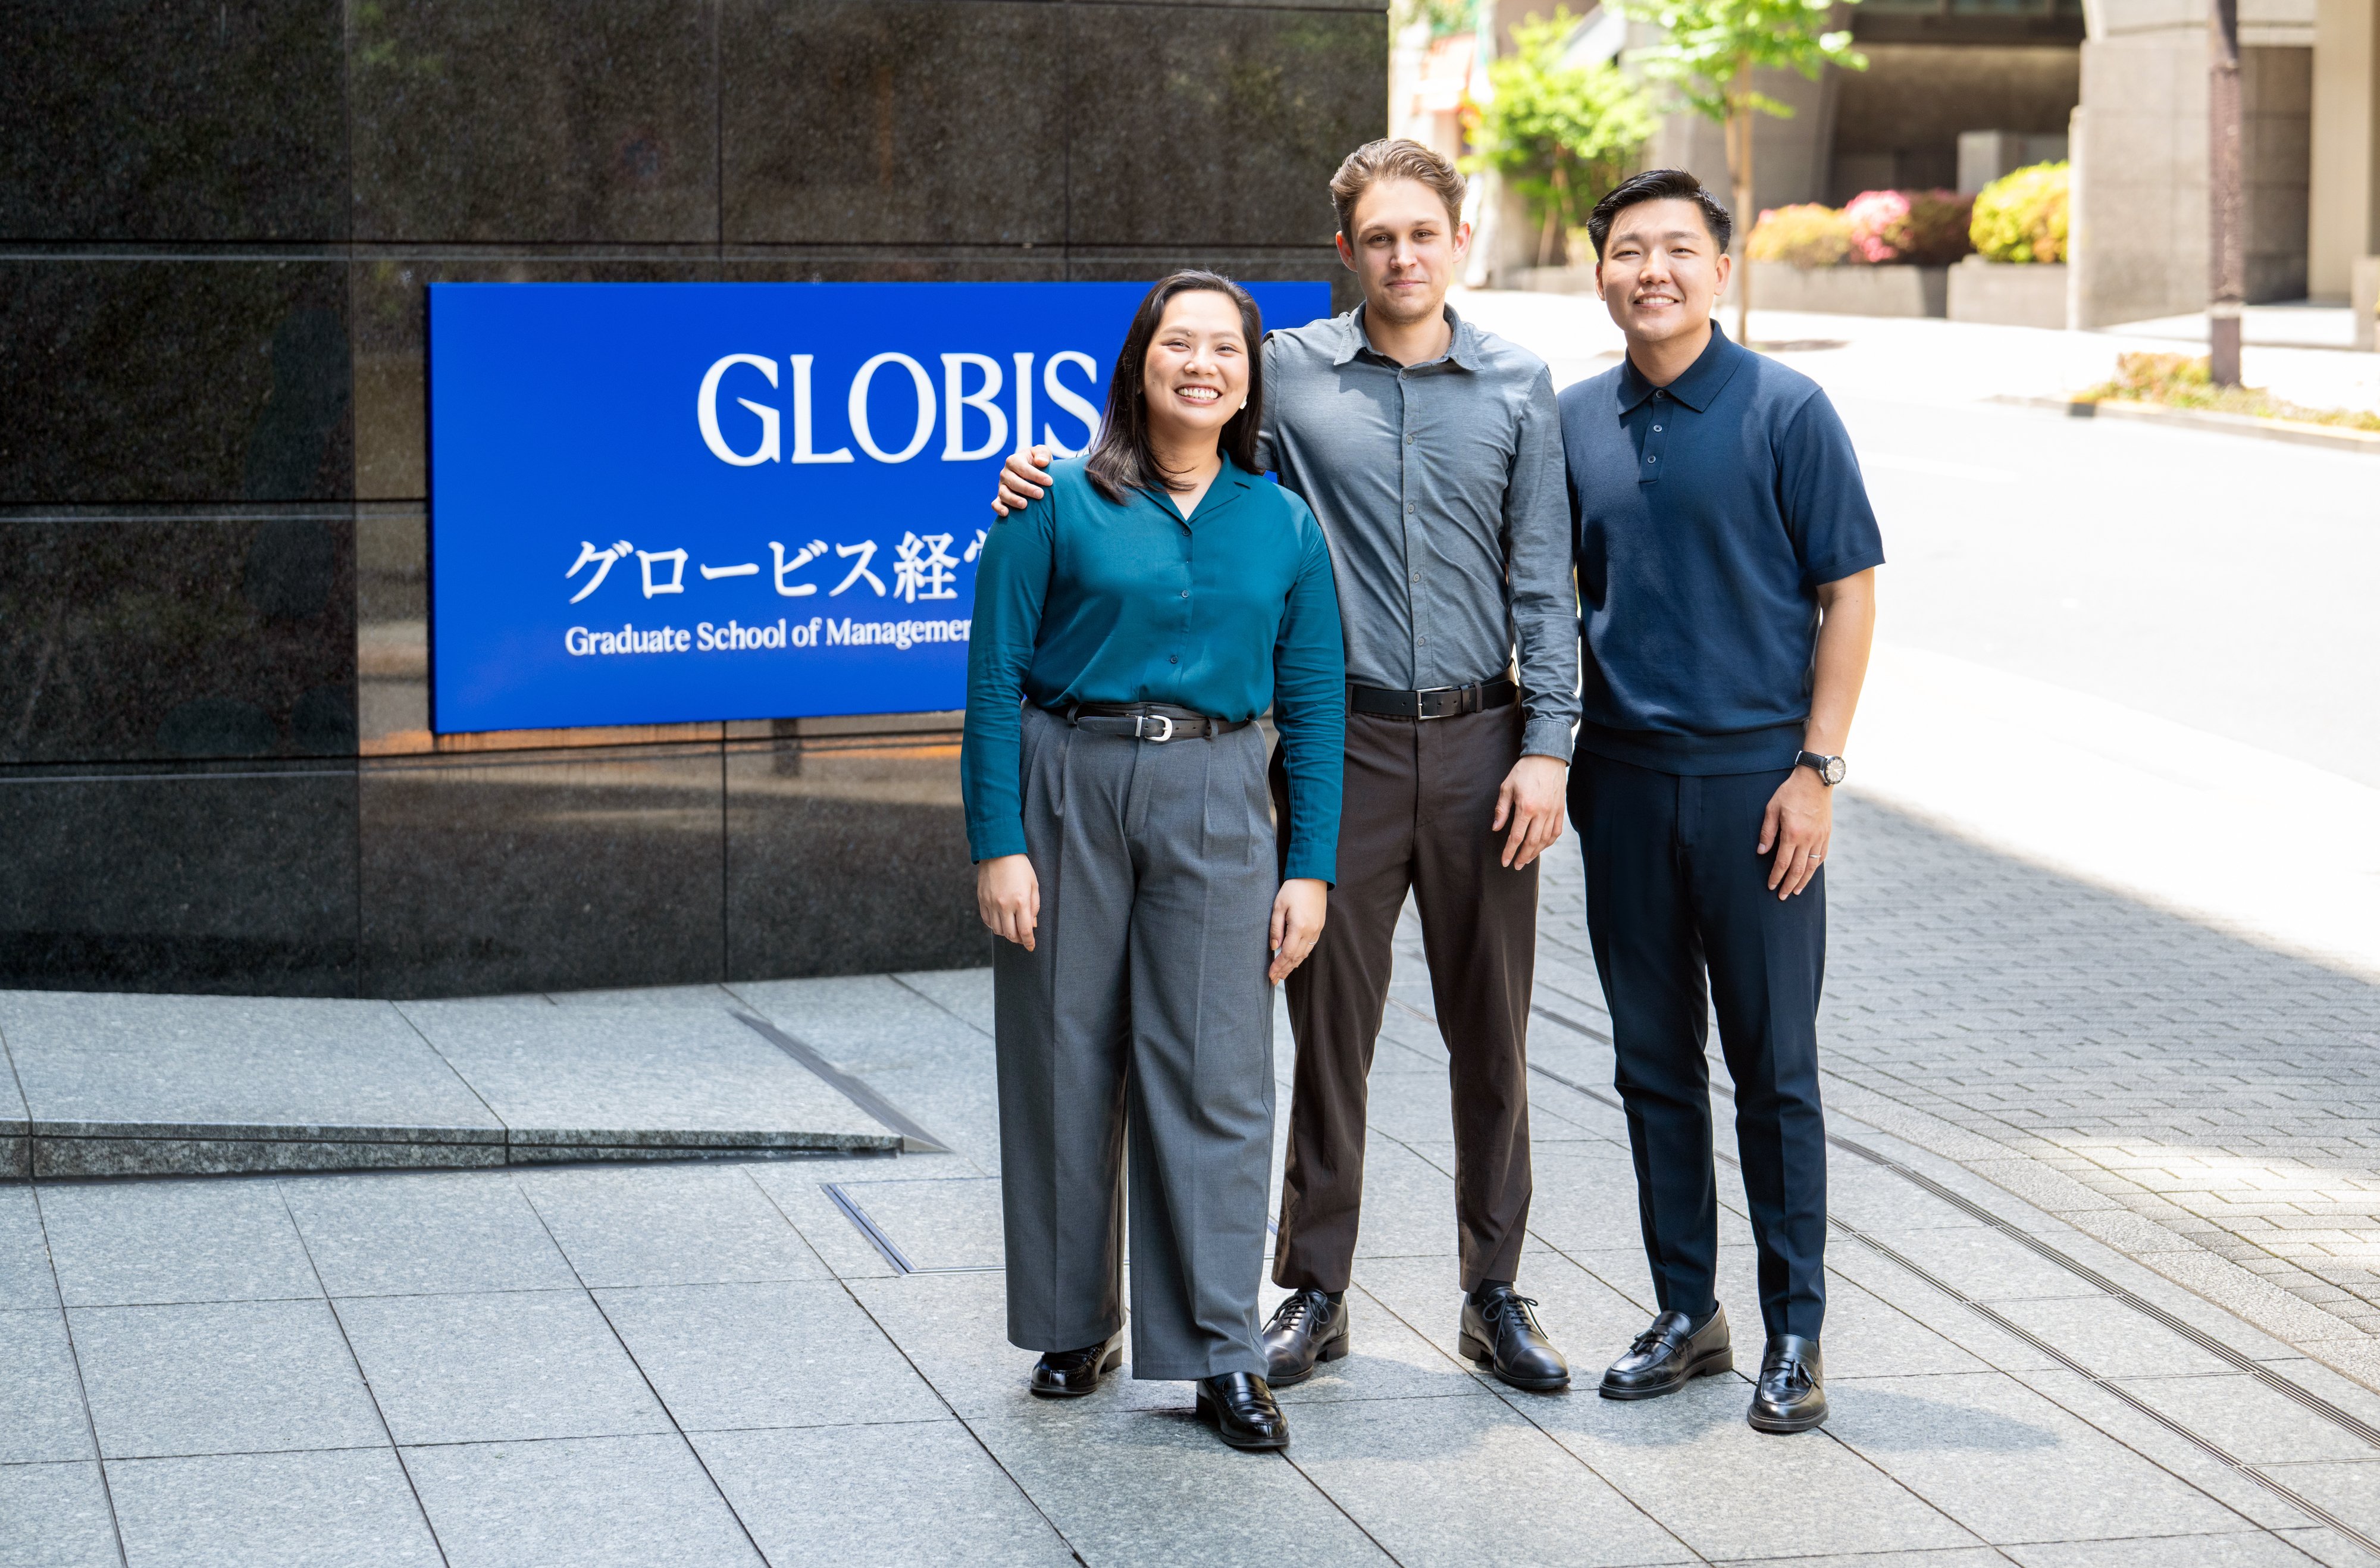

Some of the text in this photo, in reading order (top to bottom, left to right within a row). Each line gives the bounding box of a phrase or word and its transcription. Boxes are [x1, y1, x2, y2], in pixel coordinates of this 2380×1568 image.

[697, 351, 1101, 465] GLOBIS
[565, 623, 691, 656] Graduate
[697, 618, 787, 651] School
[791, 616, 822, 647] of
